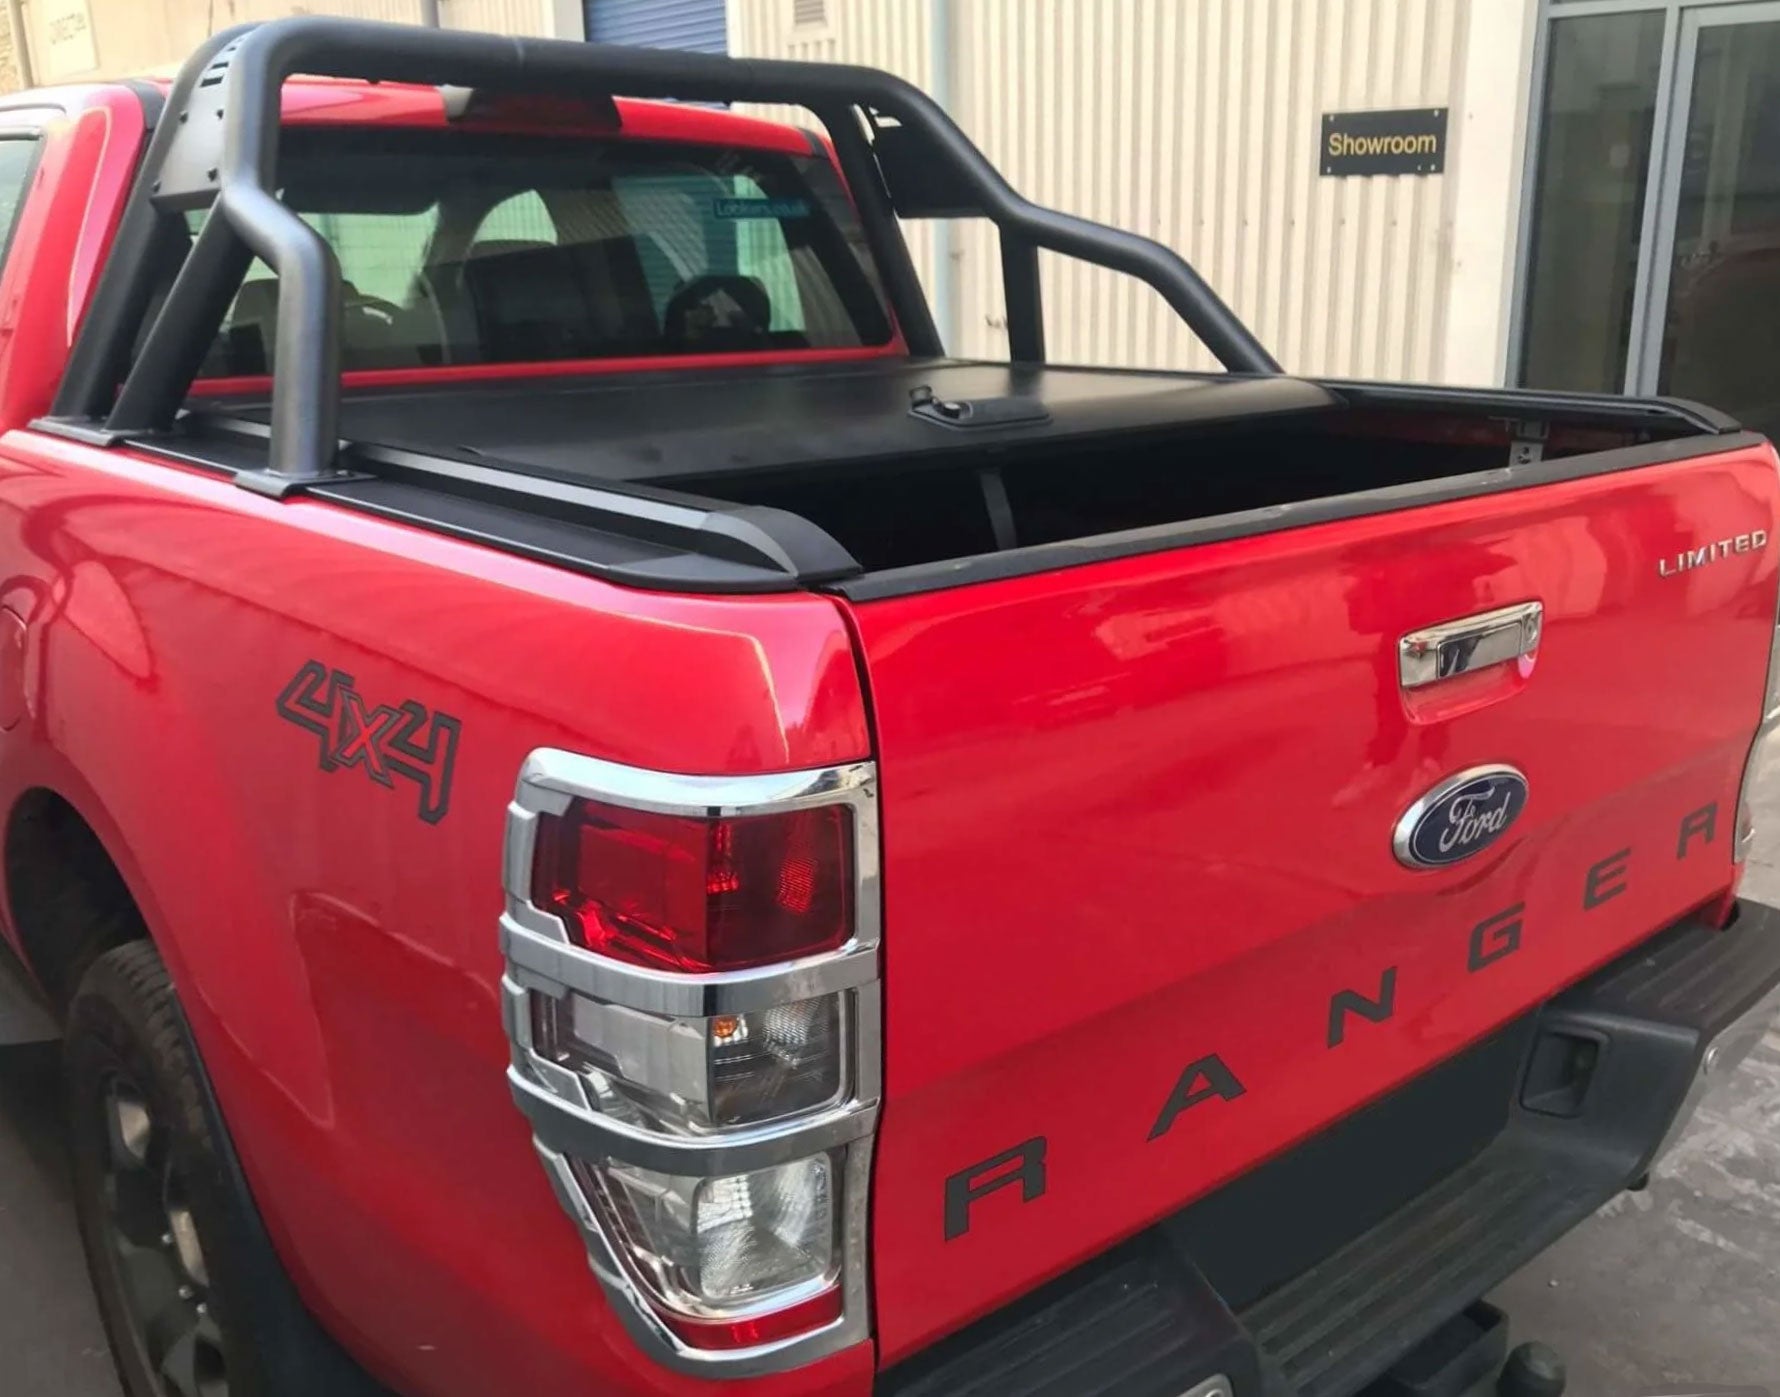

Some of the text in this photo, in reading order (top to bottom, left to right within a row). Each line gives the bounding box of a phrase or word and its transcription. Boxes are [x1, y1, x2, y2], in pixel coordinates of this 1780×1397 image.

[1328, 133, 1437, 156] Showroom
[1659, 530, 1767, 577] LIMITED
[1438, 786, 1511, 853] Ford
[944, 802, 1717, 1242] RANGER
